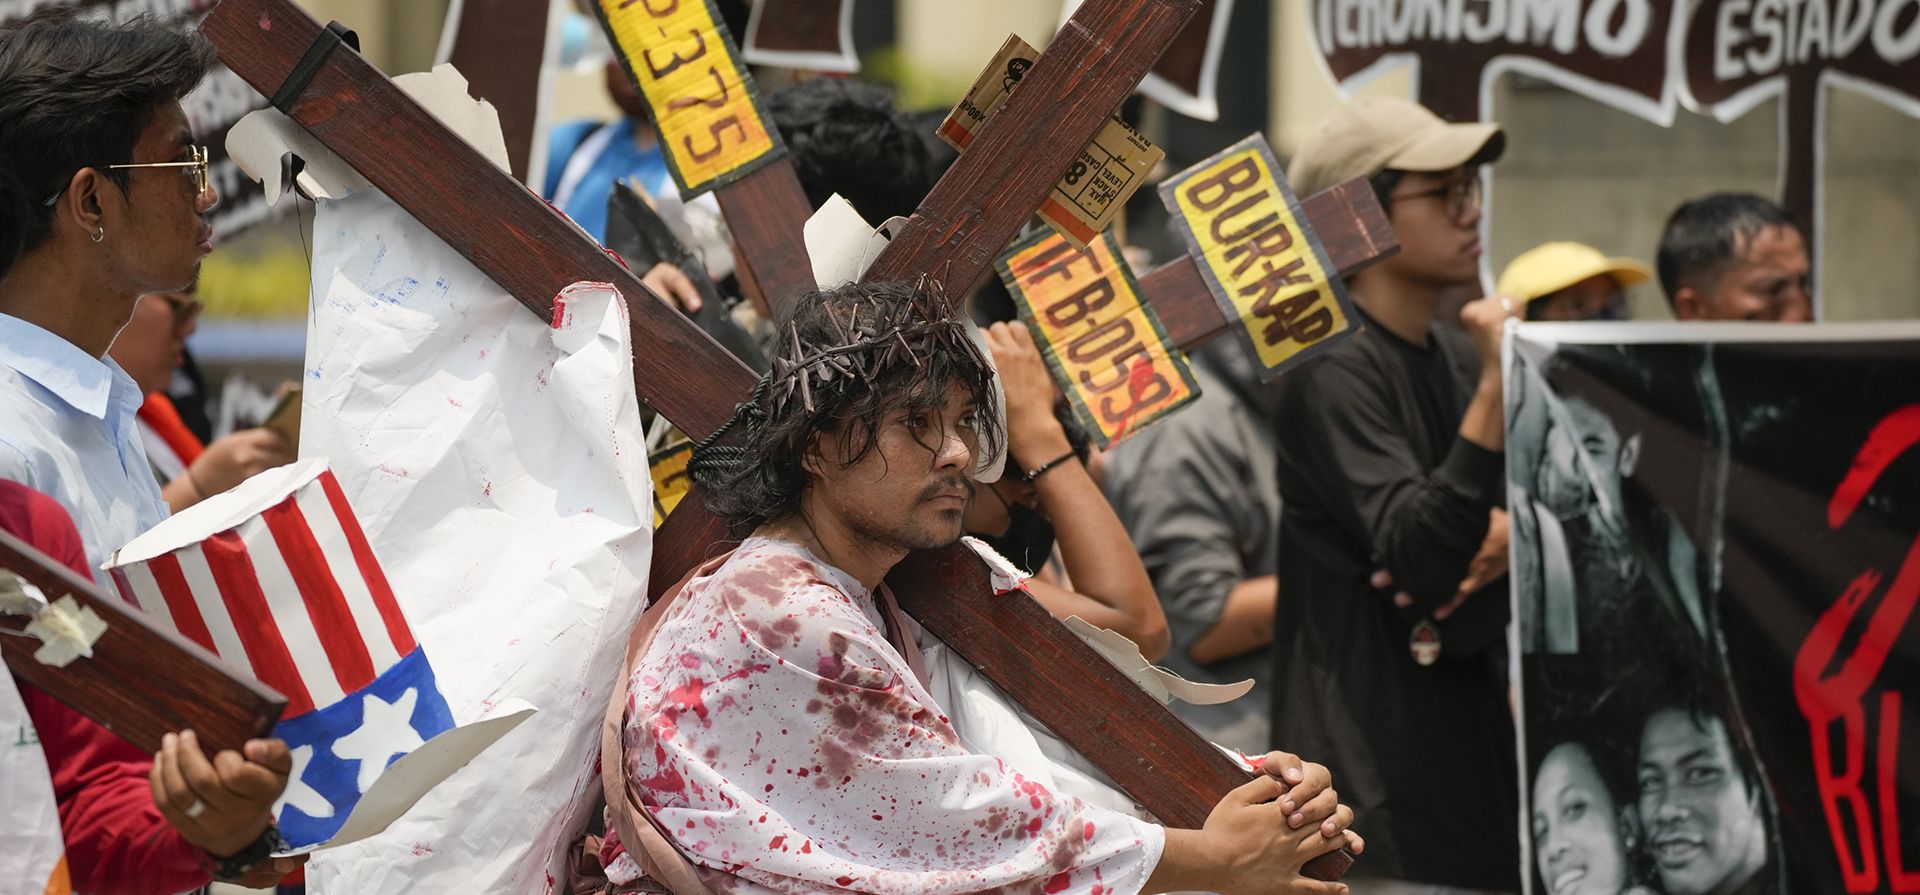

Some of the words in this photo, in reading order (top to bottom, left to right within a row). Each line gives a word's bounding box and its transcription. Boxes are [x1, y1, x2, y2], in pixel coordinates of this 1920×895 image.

[1713, 0, 1920, 82] ESTADO
[1064, 158, 1088, 187] 8
[1092, 176, 1117, 198] STACK
[1101, 167, 1124, 188] LEVEL
[1186, 155, 1333, 347] BUR-KAP
